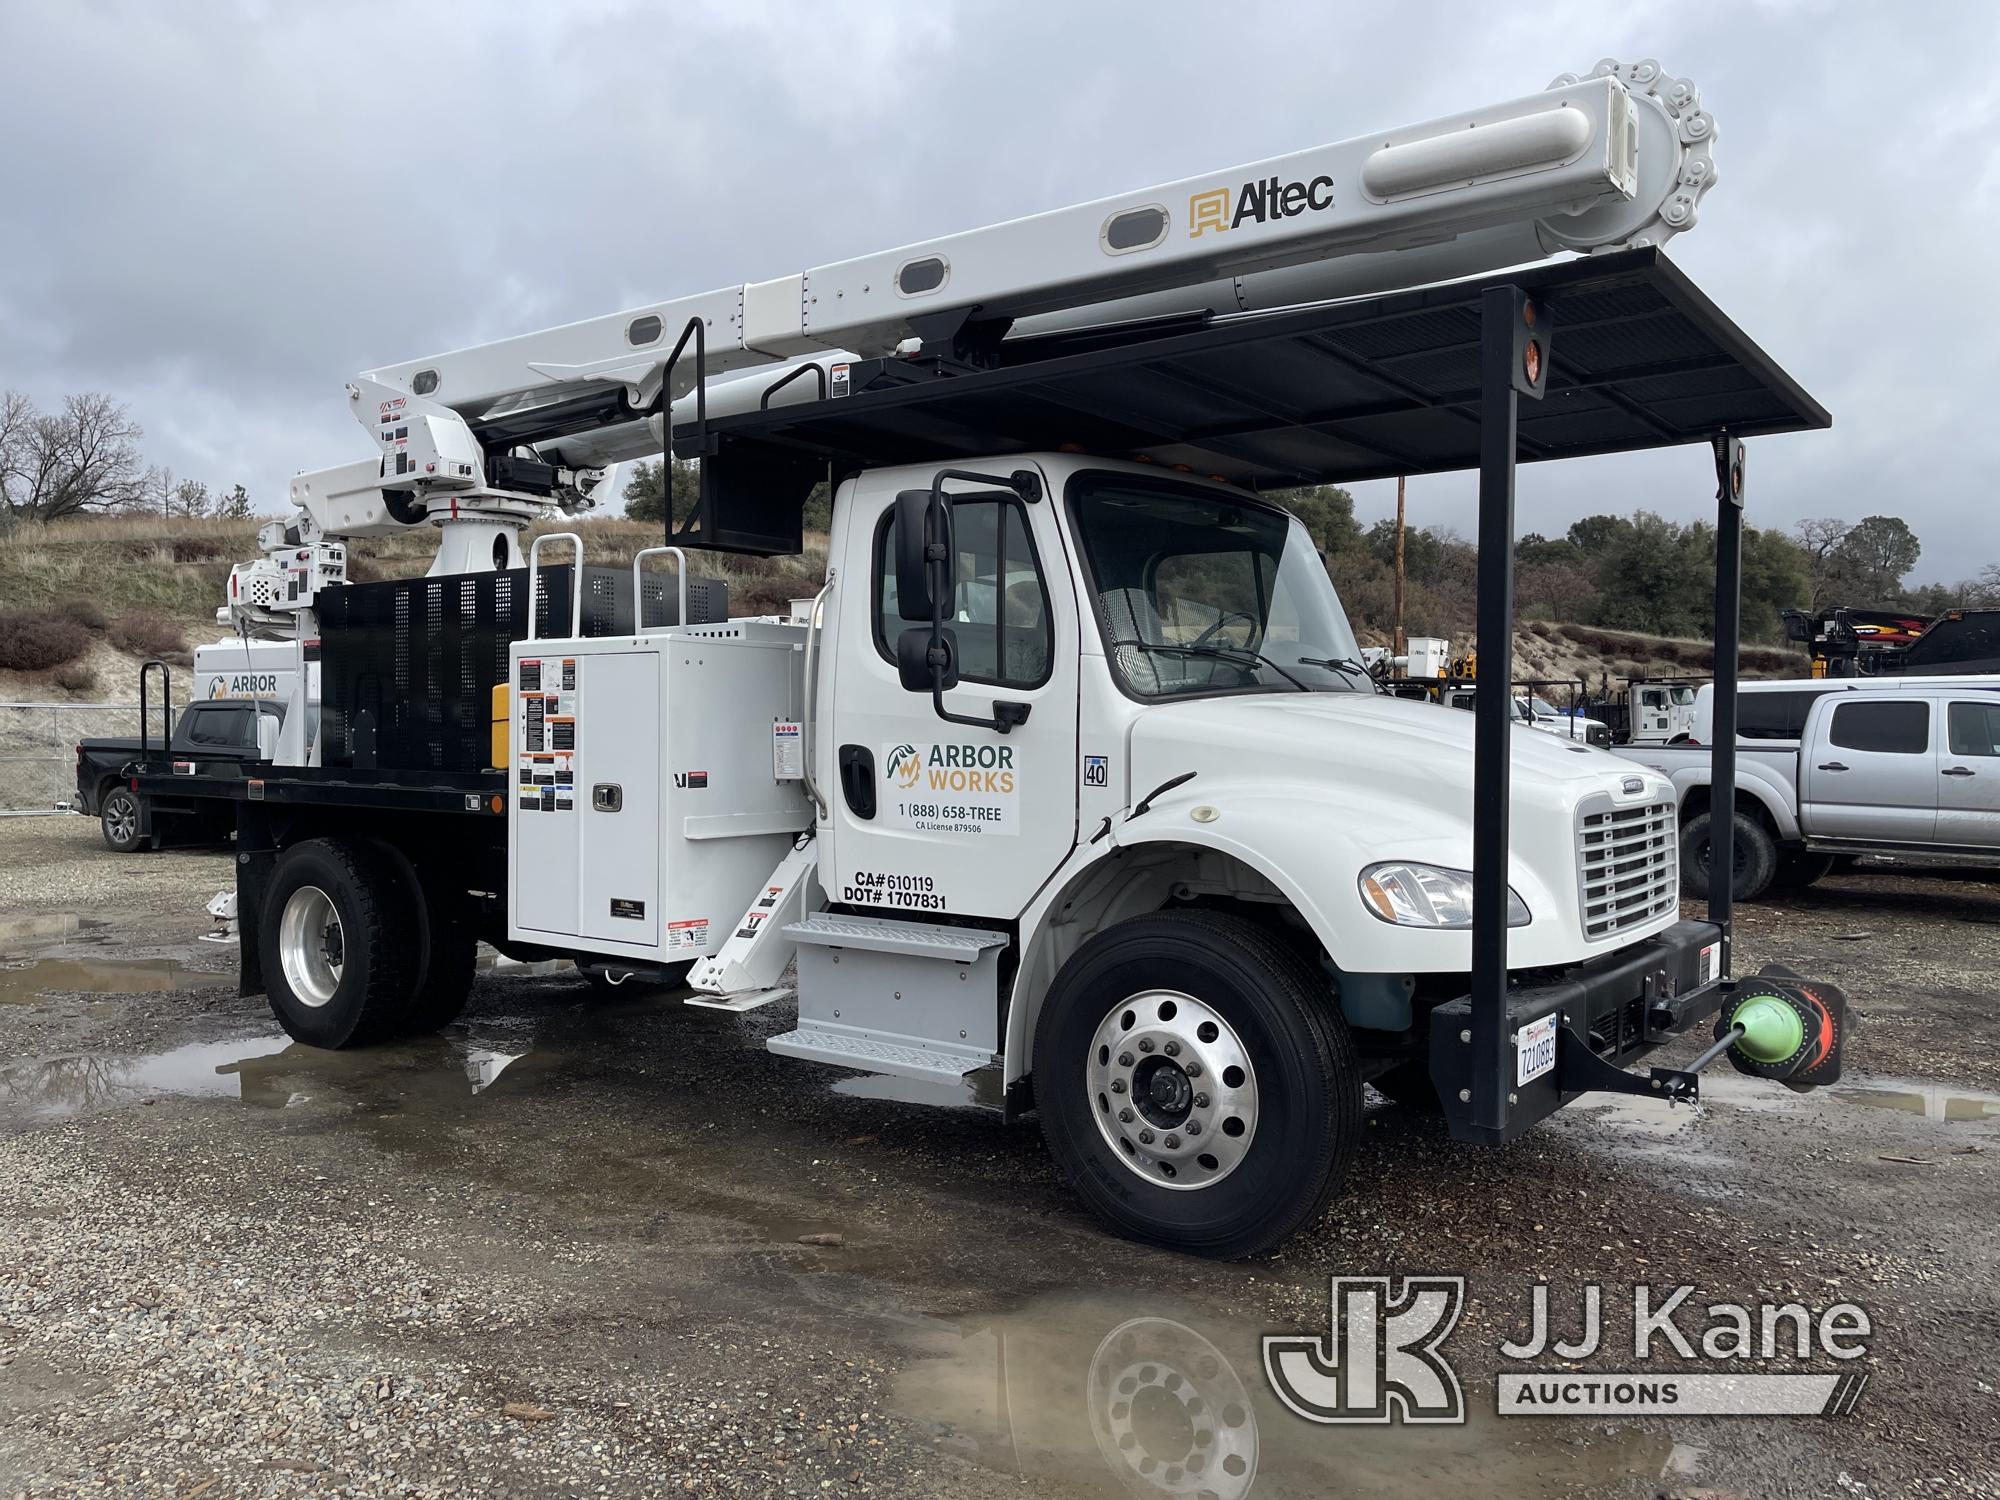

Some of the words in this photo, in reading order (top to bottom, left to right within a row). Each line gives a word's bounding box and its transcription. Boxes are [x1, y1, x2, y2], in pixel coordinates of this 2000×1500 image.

[1230, 175, 1334, 230] Altec
[231, 675, 277, 692] ARBOR
[928, 744, 1014, 769] ARBOR
[928, 770, 1014, 793] WORKS
[1086, 765, 1105, 784] 40
[899, 803, 904, 816] 1
[908, 803, 939, 820] (888)
[942, 805, 1002, 821] 658-TREE
[915, 821, 926, 830] CA
[927, 822, 953, 831] License
[954, 823, 982, 833] 879506
[887, 874, 934, 892] 610119
[844, 886, 883, 903] DOT#
[887, 891, 946, 910] 1707831
